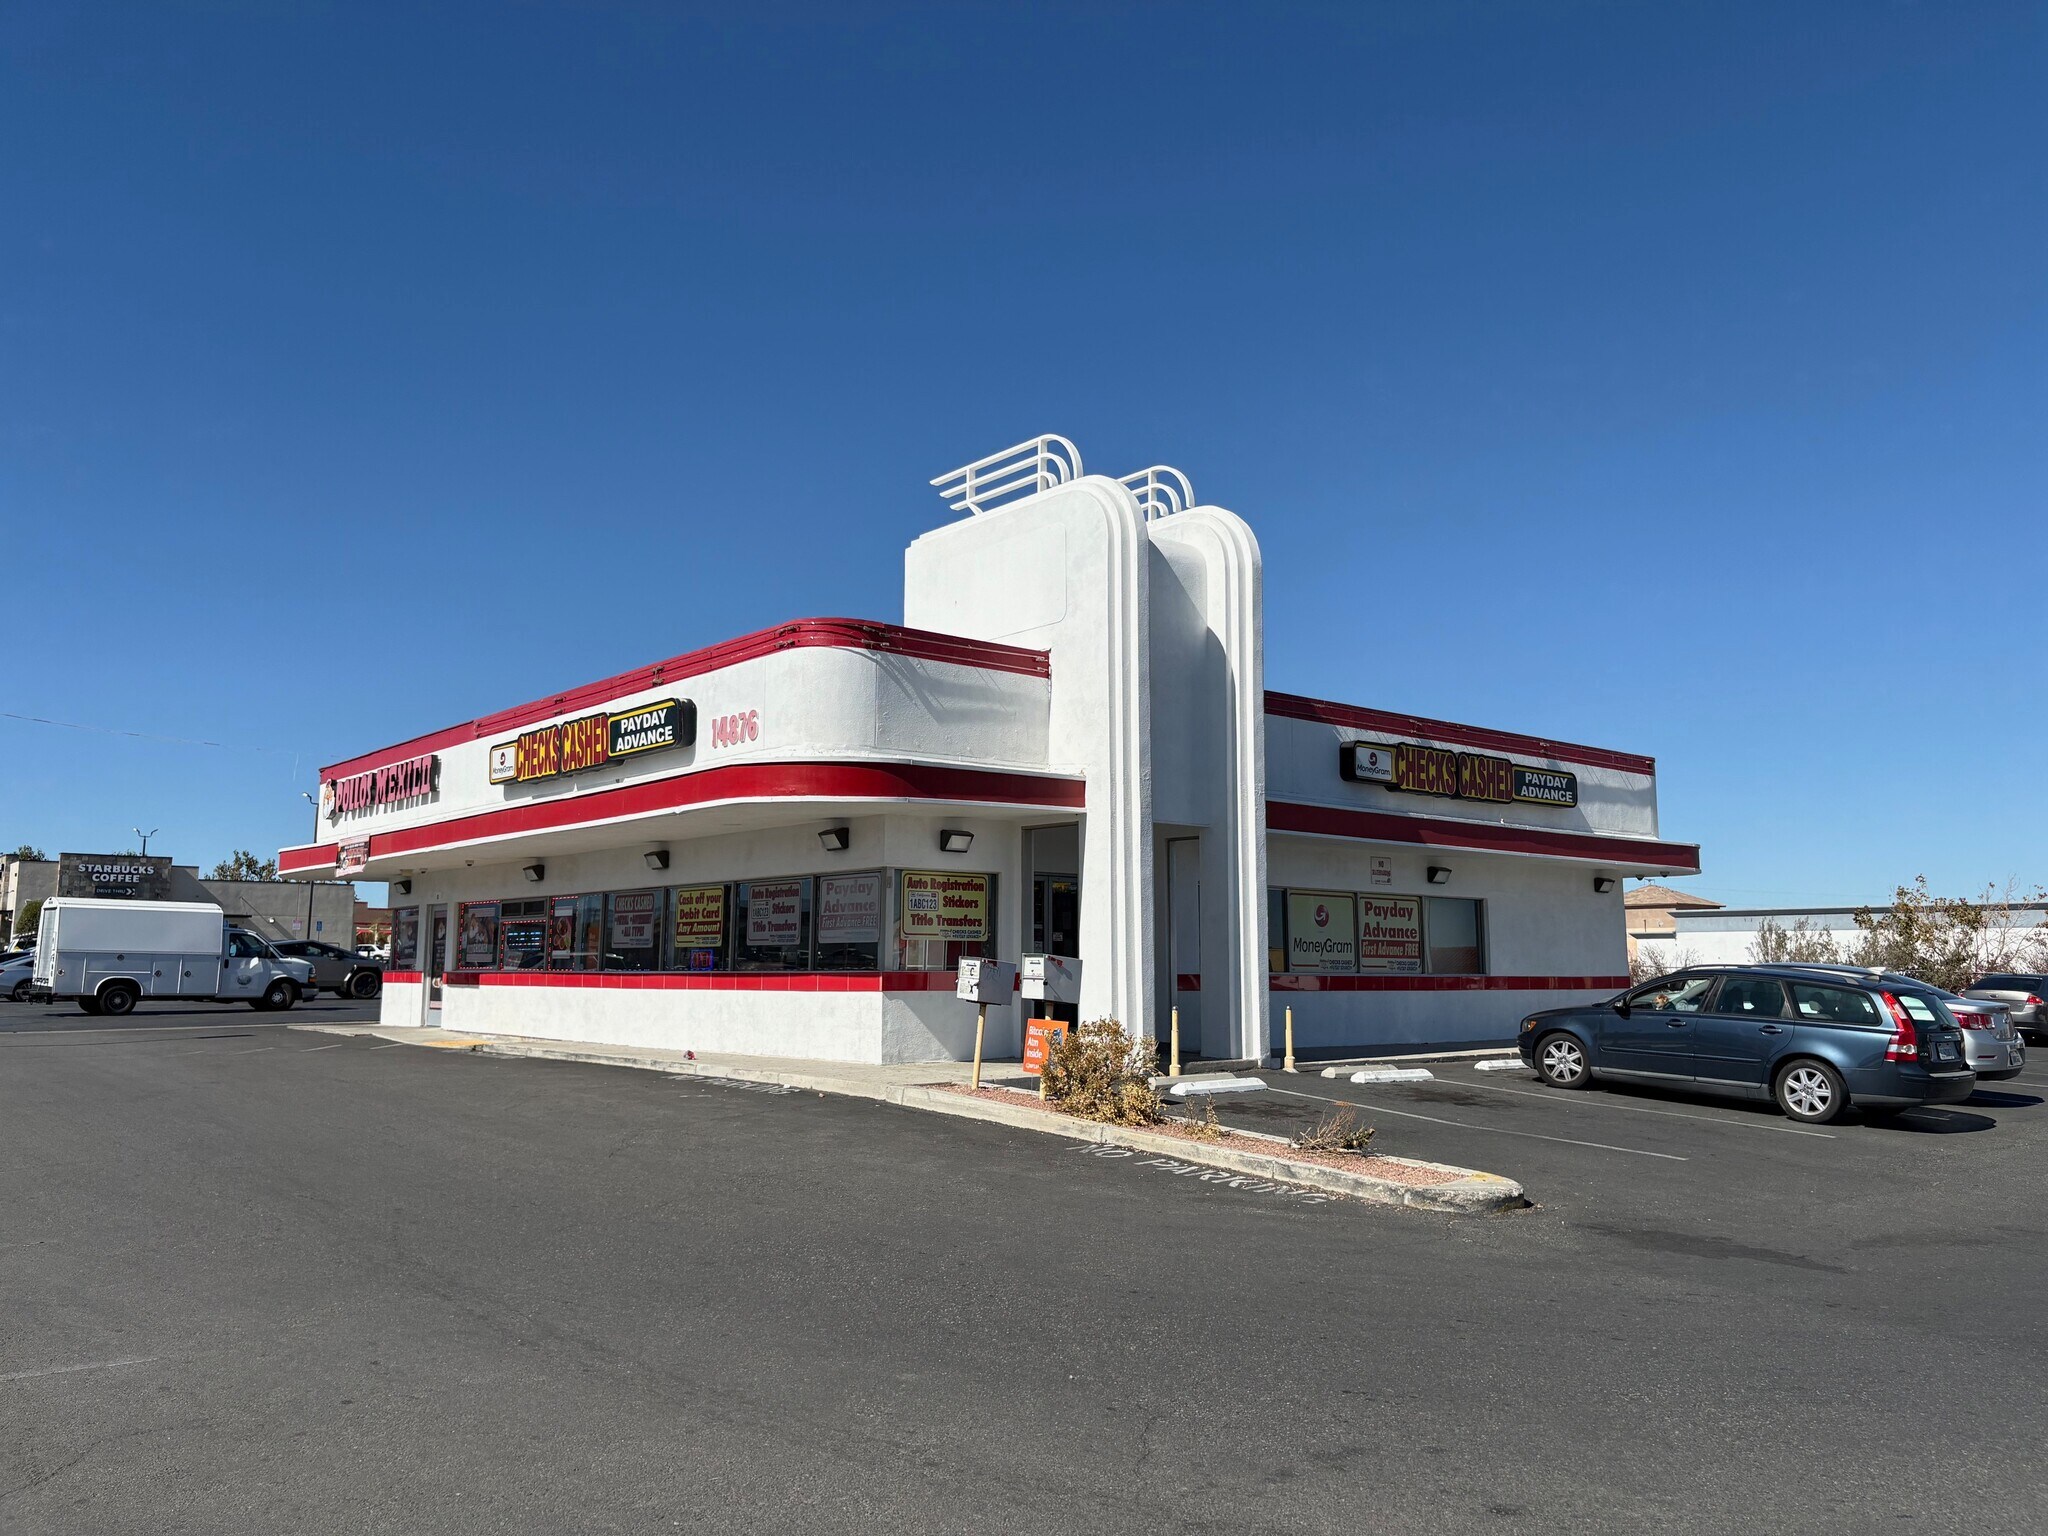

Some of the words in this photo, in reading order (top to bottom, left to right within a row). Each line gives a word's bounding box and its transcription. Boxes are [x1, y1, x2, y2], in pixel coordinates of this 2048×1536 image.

[620, 708, 668, 734] PAYDAY
[711, 709, 760, 749] 14876
[615, 725, 674, 752] ADVANCE
[518, 727, 560, 781] CHECKS
[561, 715, 609, 771] CASHED
[492, 764, 515, 775] MoneyGram
[1356, 763, 1391, 776] MoneyGram
[1394, 744, 1457, 795] CHECKS
[1459, 753, 1512, 800] CASHED
[335, 772, 373, 812] POLLOS
[374, 755, 433, 804] MEXICO
[1524, 771, 1568, 790] PAYDAY
[1520, 785, 1573, 803] ADVANCE
[78, 863, 155, 875] STARBUCKS
[91, 873, 140, 883] COFFEE
[906, 876, 929, 890] Auto
[930, 877, 985, 893] Registration
[751, 888, 764, 900] Auto
[764, 886, 800, 900] Registration
[826, 880, 874, 896] Payday
[679, 894, 694, 906] Cash
[694, 892, 705, 904] off
[706, 894, 722, 906] your
[909, 898, 937, 910] 1ABC123
[942, 895, 979, 909] Stickers
[679, 907, 701, 920] Debit
[702, 907, 720, 919] Card
[771, 900, 796, 915] Stickers
[824, 900, 876, 914] Advance
[1364, 901, 1414, 921] Payday
[678, 923, 691, 934] Any
[692, 922, 720, 932] Amount
[752, 921, 767, 933] Title
[767, 920, 798, 932] Transfers
[822, 917, 835, 928] First
[835, 916, 861, 928] Advance
[862, 915, 877, 927] FREE
[910, 913, 934, 926] Title
[936, 914, 983, 928] Transfers
[1362, 921, 1418, 940] Advance
[1293, 937, 1353, 957] MoneyGram
[1362, 941, 1377, 955] First
[1377, 942, 1404, 956] Advance
[1404, 943, 1419, 956] FREE
[1026, 1048, 1043, 1059] Inside
[1066, 1143, 1133, 1158] NO
[1134, 1158, 1328, 1204] PARKING
